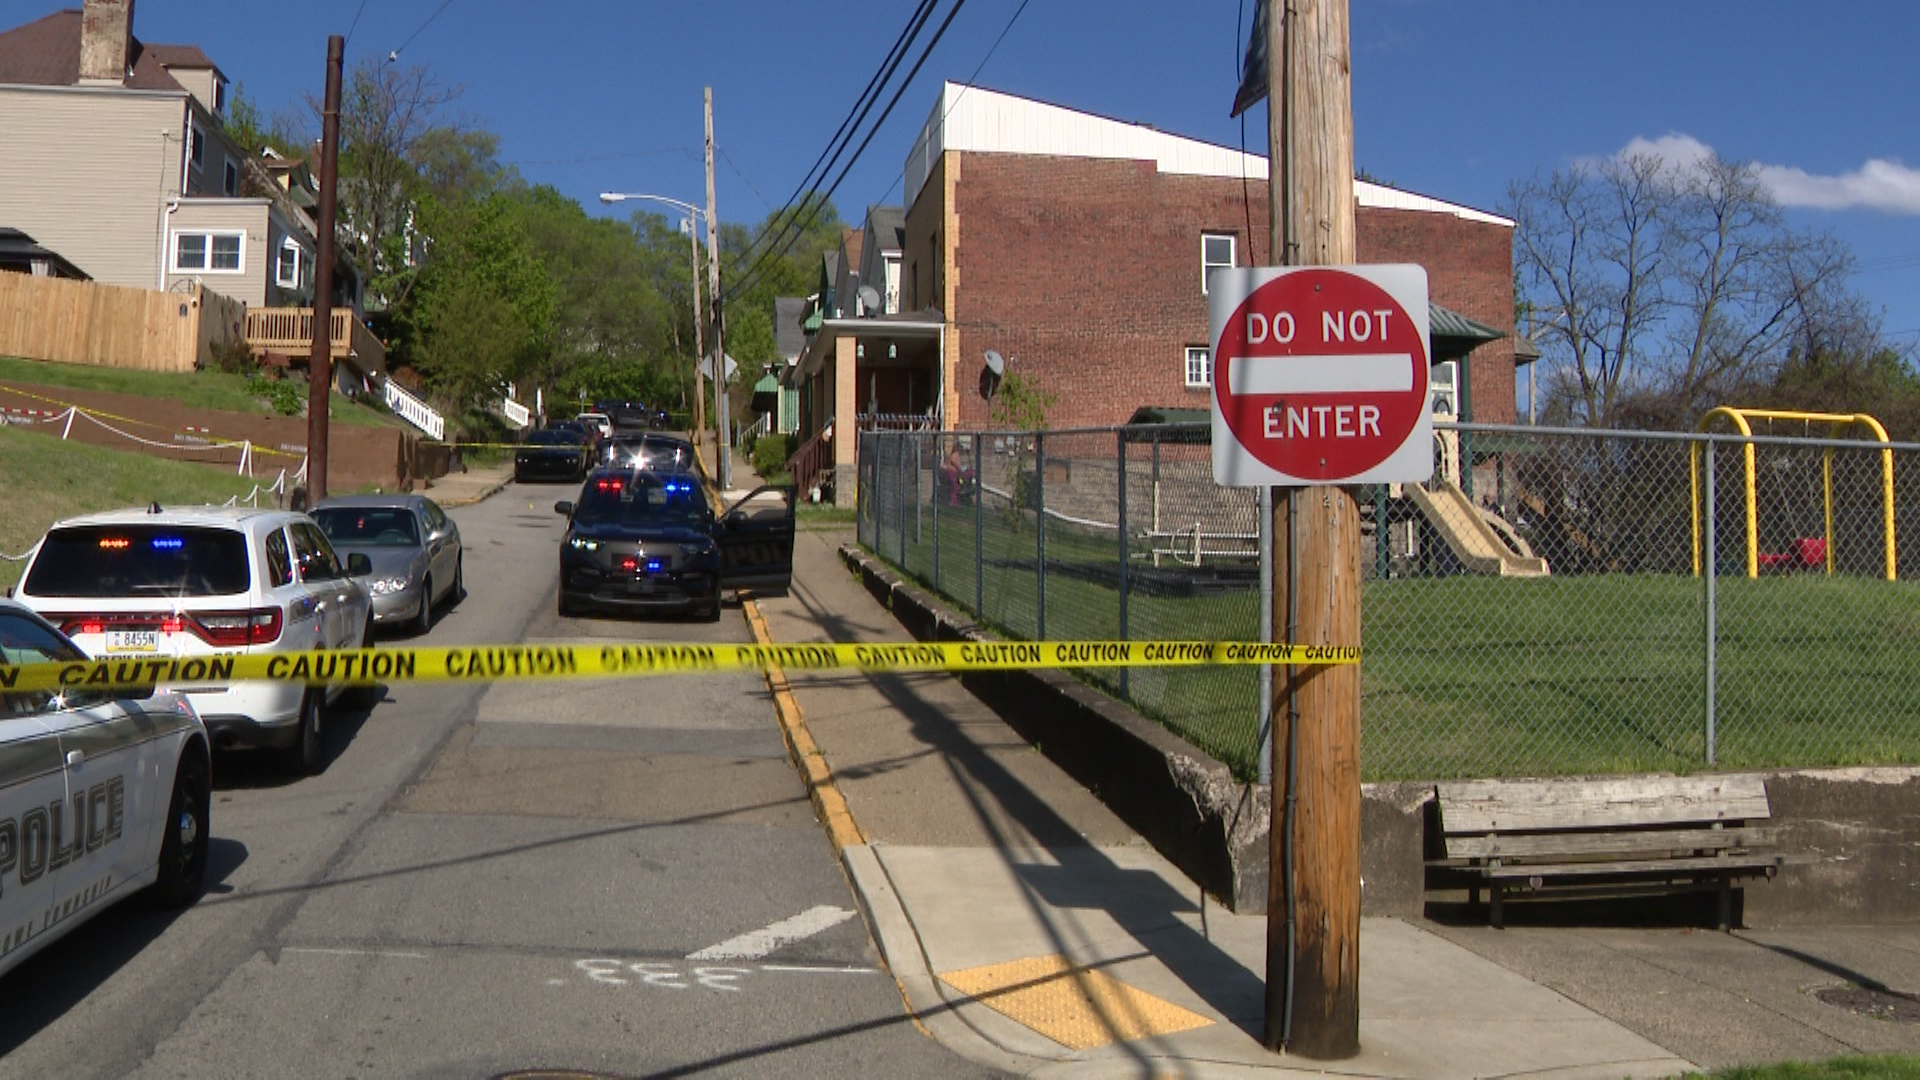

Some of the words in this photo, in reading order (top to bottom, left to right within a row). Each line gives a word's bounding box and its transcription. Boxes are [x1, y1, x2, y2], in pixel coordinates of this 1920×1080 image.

[1247, 311, 1295, 344] DO
[1322, 309, 1393, 342] NOT
[1263, 405, 1381, 439] ENTER
[124, 633, 155, 646] 8455N
[58, 659, 234, 685] CAUTION
[266, 652, 415, 680] CAUTION
[445, 648, 576, 677] CAUTION
[600, 646, 718, 672] CAUTION
[735, 646, 838, 667] CAUTION
[856, 646, 947, 666] CAUTION
[960, 644, 1041, 663] CAUTION
[1056, 643, 1130, 662] CAUTION
[1143, 643, 1215, 661] CAUTION
[1225, 644, 1294, 660] CAUTION
[0, 775, 124, 900] POLICE
